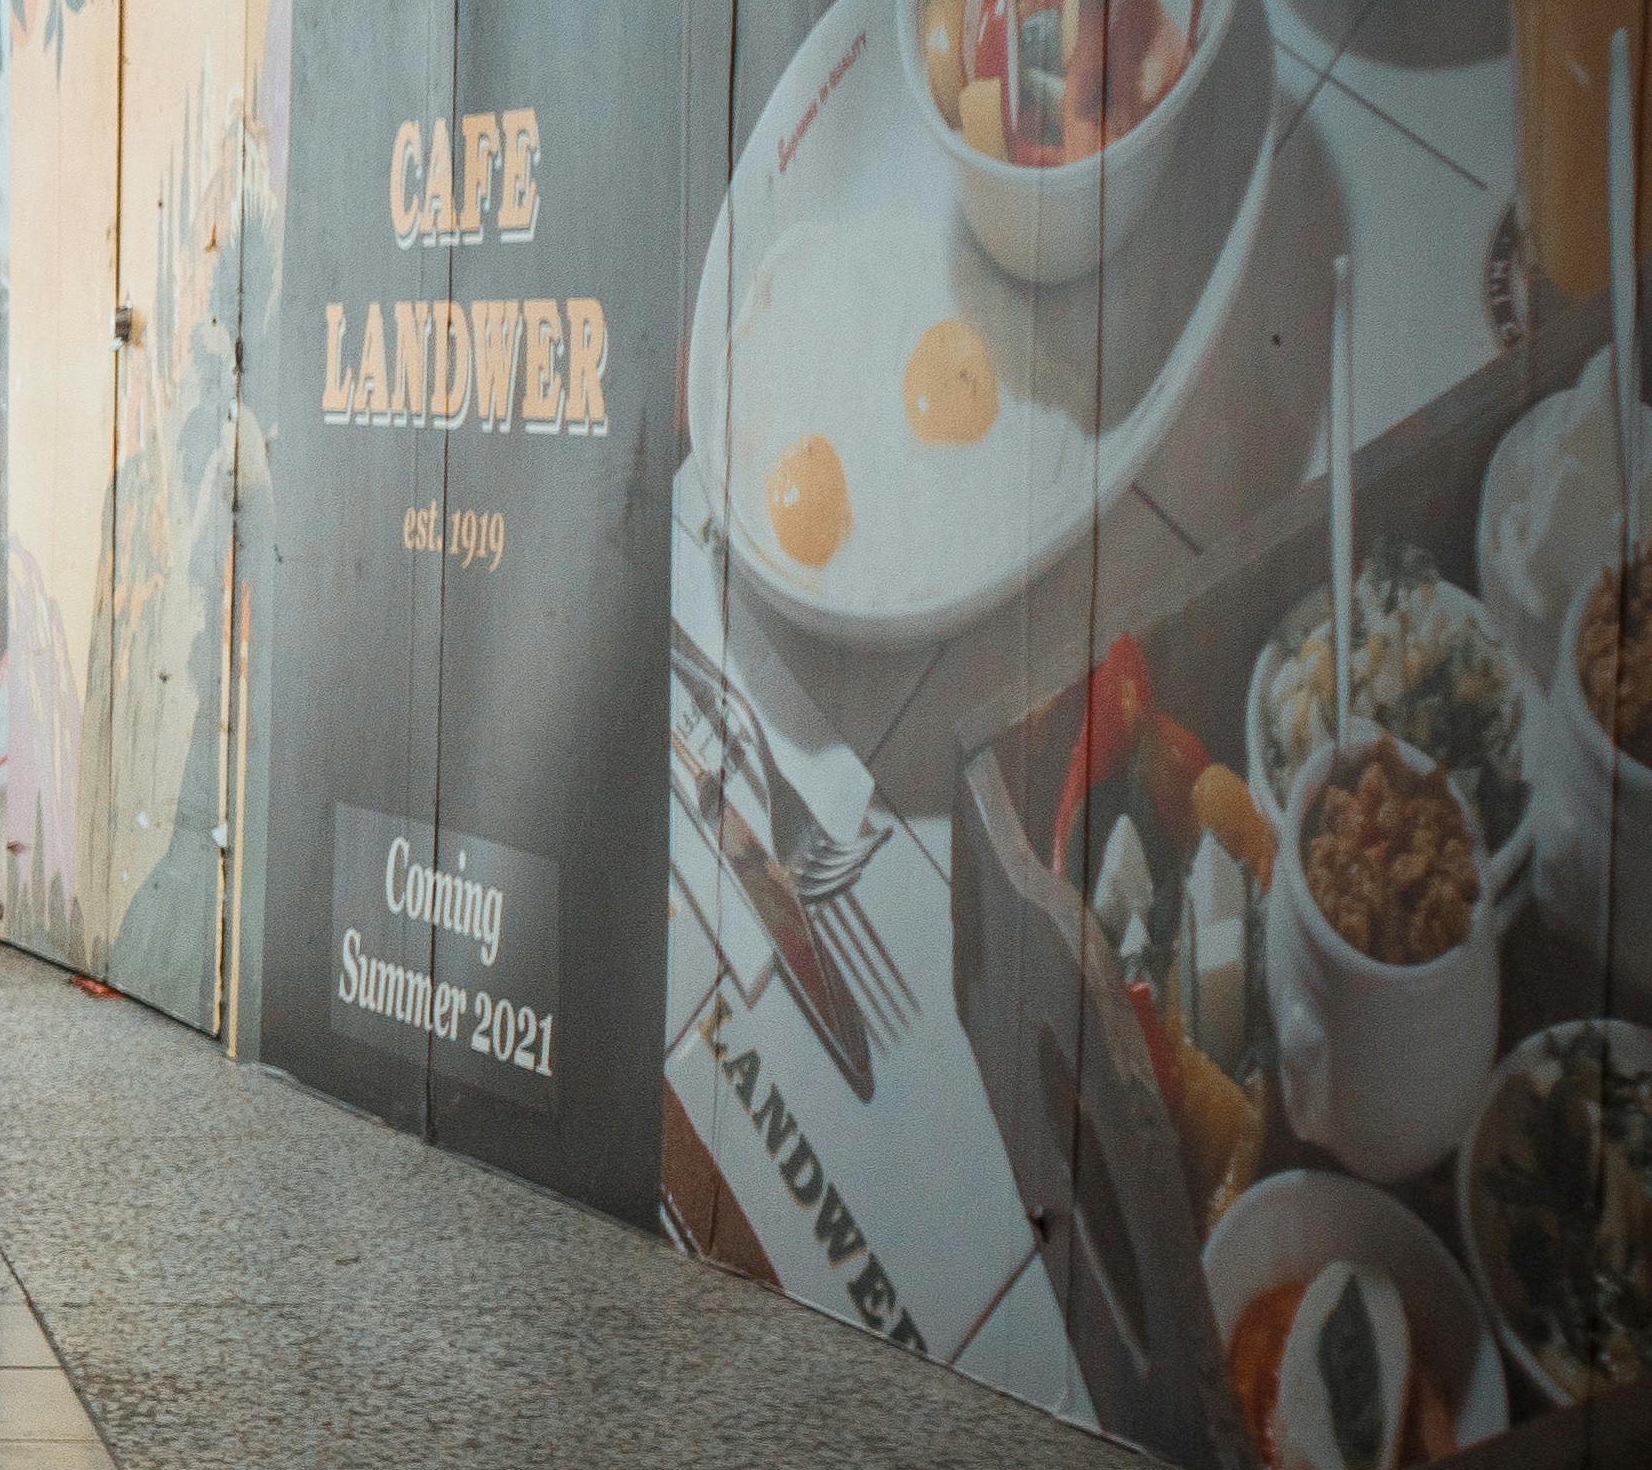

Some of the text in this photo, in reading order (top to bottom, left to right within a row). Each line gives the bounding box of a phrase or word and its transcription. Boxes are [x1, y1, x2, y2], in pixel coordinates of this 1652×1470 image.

[389, 107, 541, 250] CAFE
[322, 298, 609, 437] LANDWER
[403, 501, 505, 572] est. 1919
[385, 836, 505, 965] Coming
[338, 928, 553, 1077] Summer 2021
